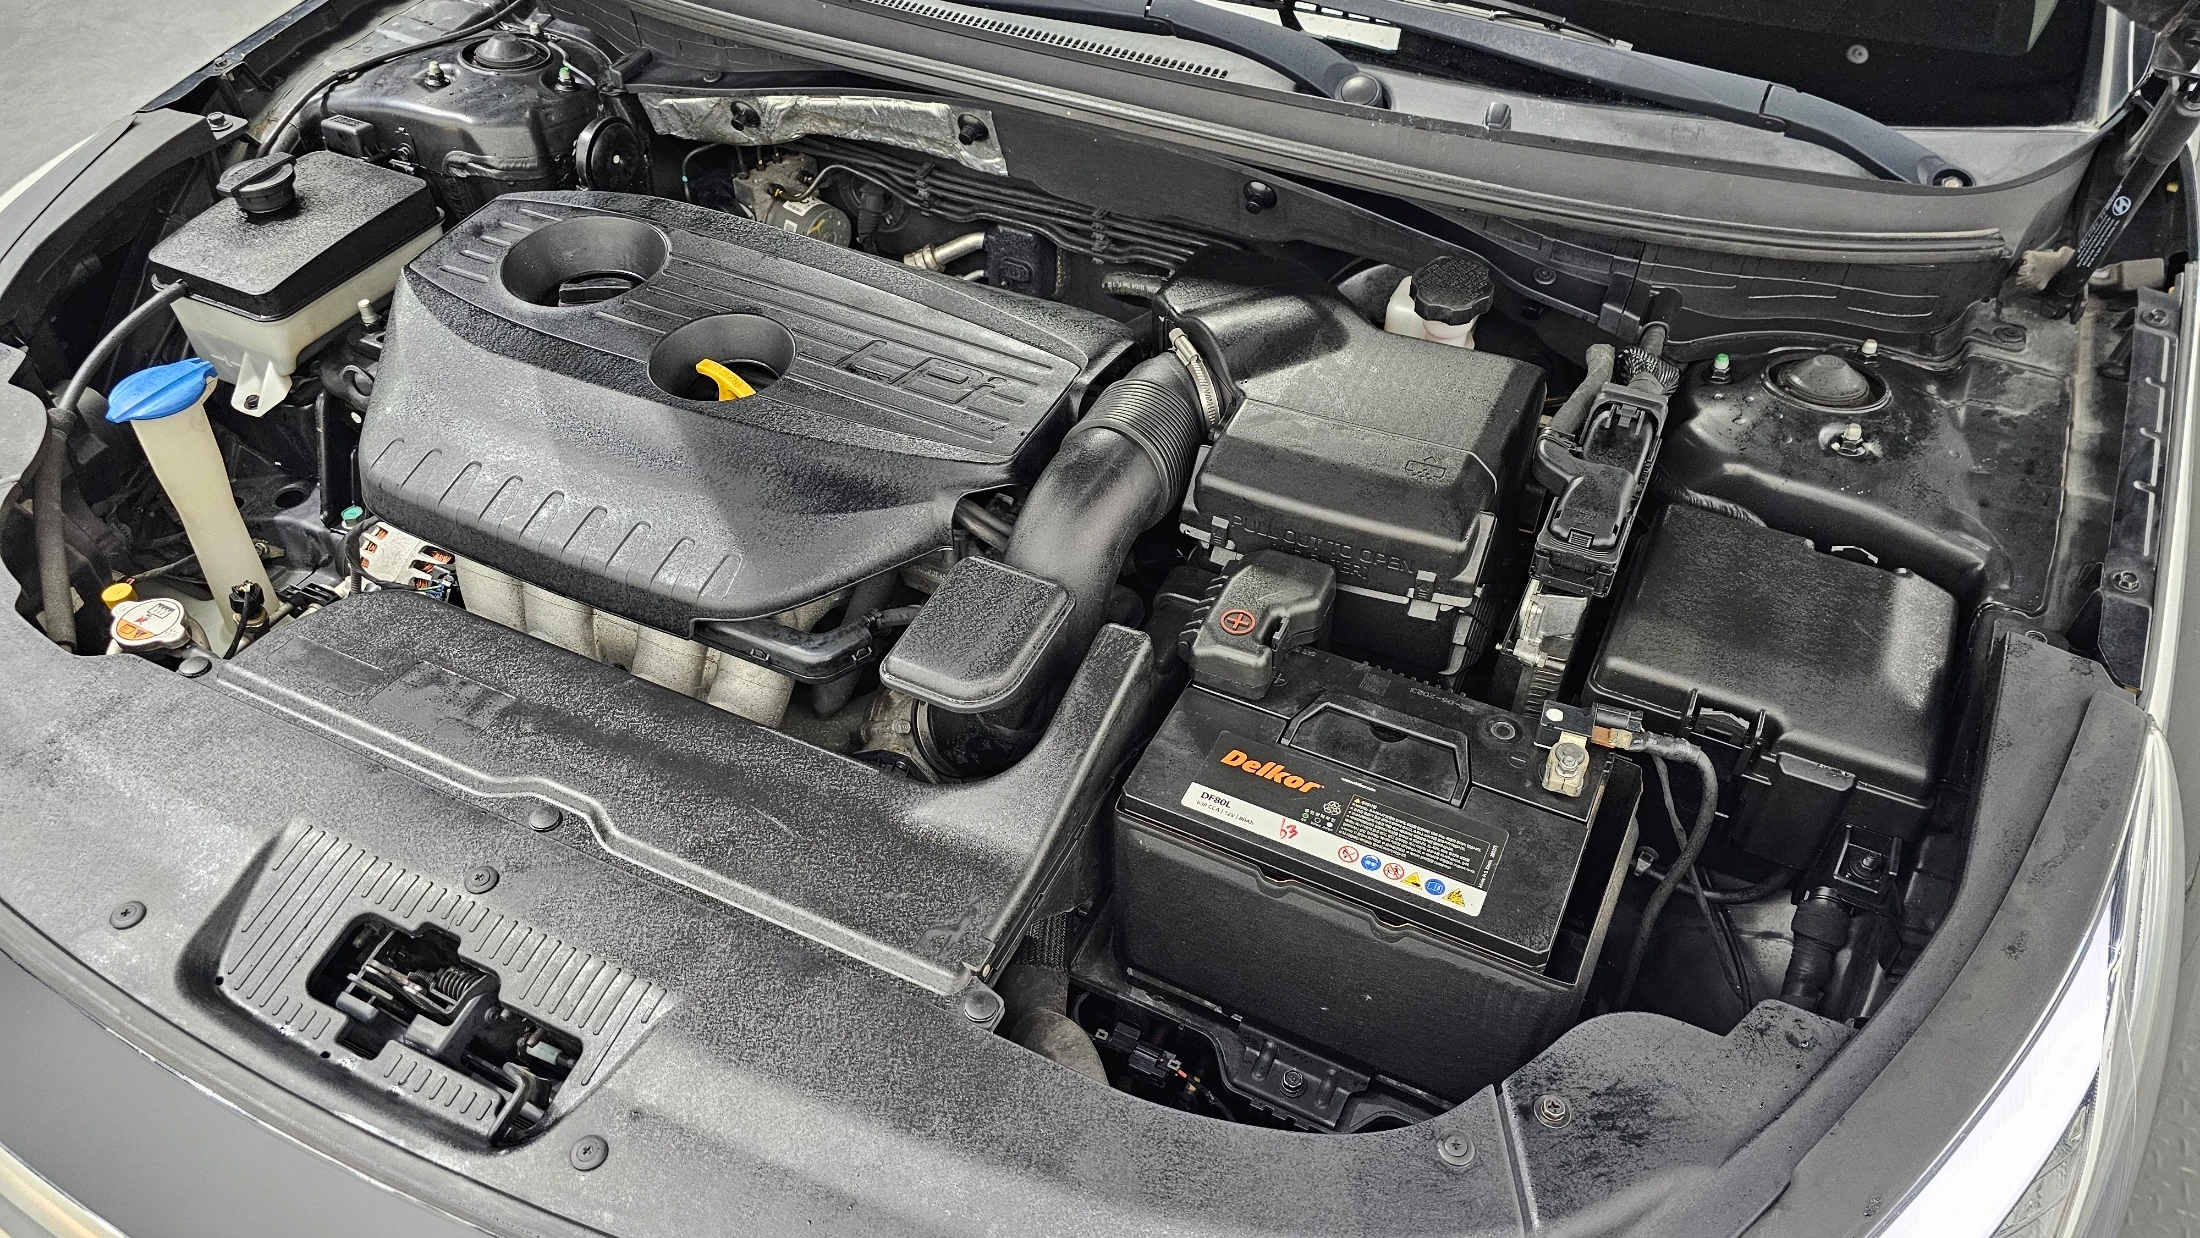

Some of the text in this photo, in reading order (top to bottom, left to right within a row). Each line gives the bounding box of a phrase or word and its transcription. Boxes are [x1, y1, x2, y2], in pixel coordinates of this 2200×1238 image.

[1231, 515, 1415, 574] PULL OUT TO OPEN
[1220, 749, 1322, 792] Delkor
[1200, 791, 1231, 808] DF80L
[1208, 804, 1220, 812] CCA
